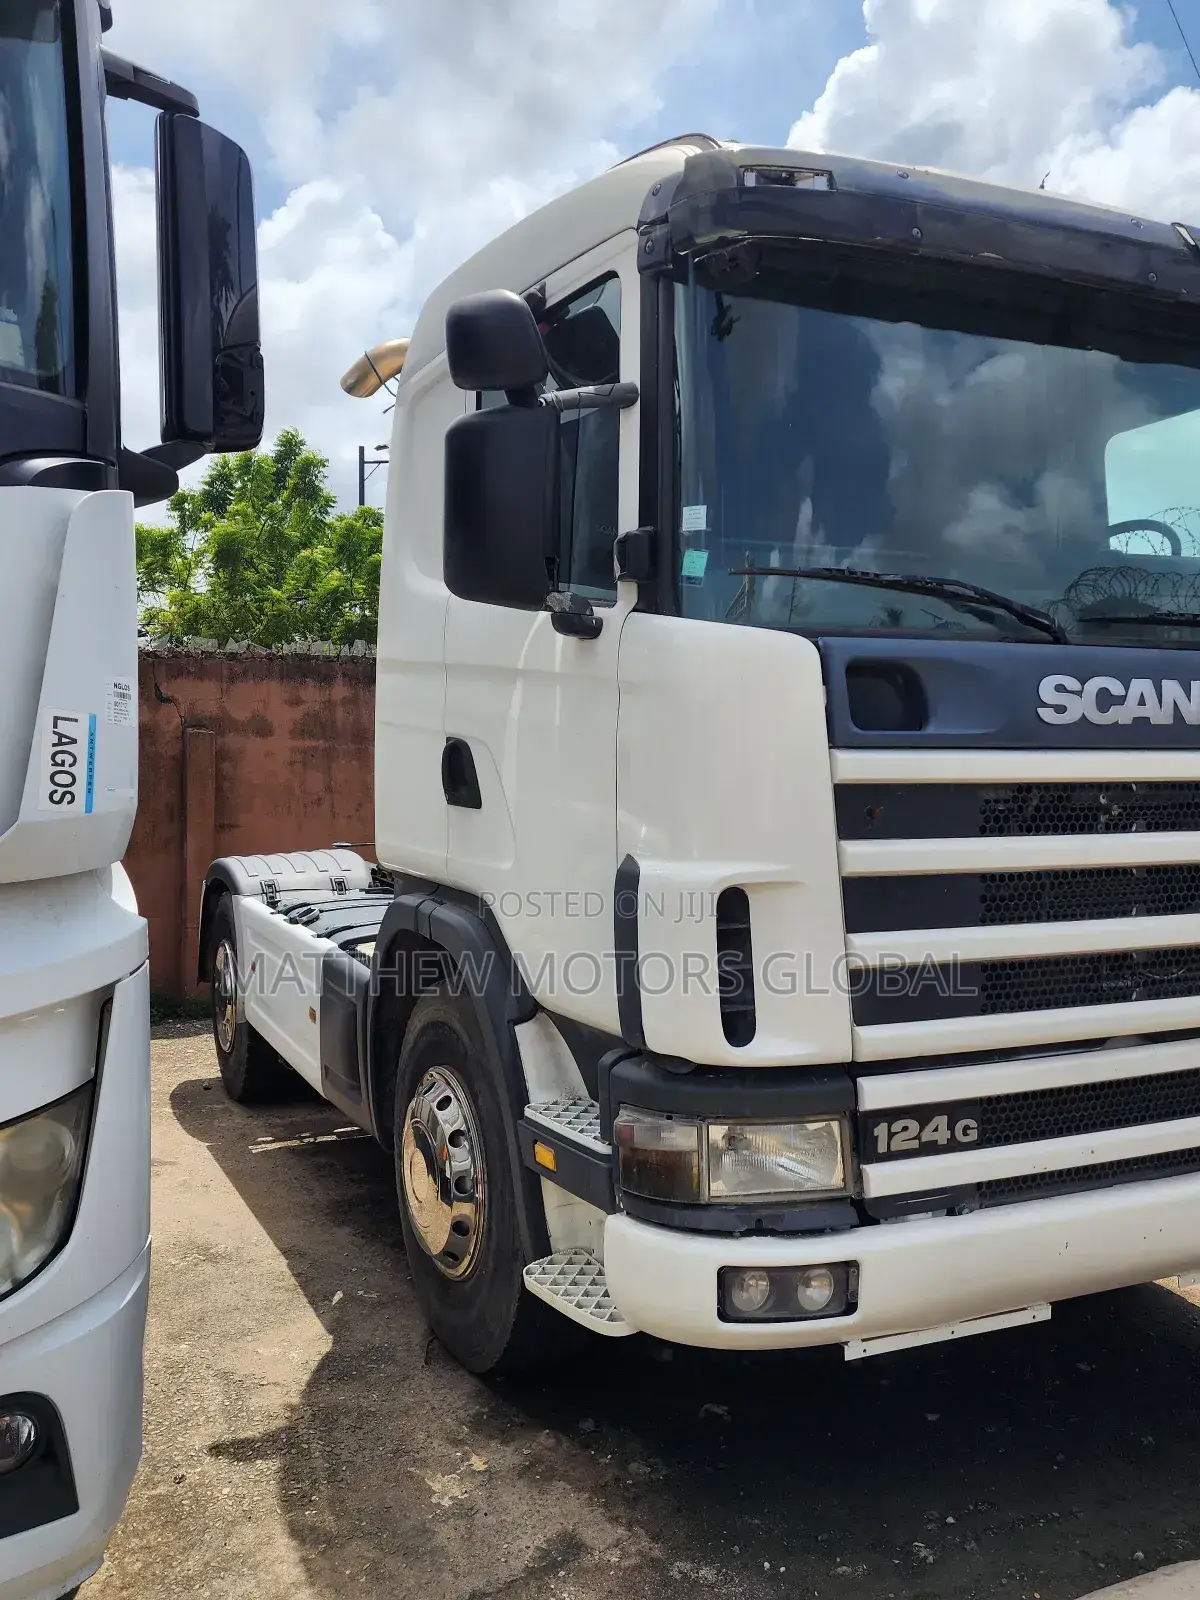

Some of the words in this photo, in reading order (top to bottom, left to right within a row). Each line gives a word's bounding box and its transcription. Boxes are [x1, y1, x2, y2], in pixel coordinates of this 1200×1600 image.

[1036, 674, 1200, 725] SCAN
[48, 715, 78, 805] LAGOS
[87, 732, 95, 794] ANTWERPEN
